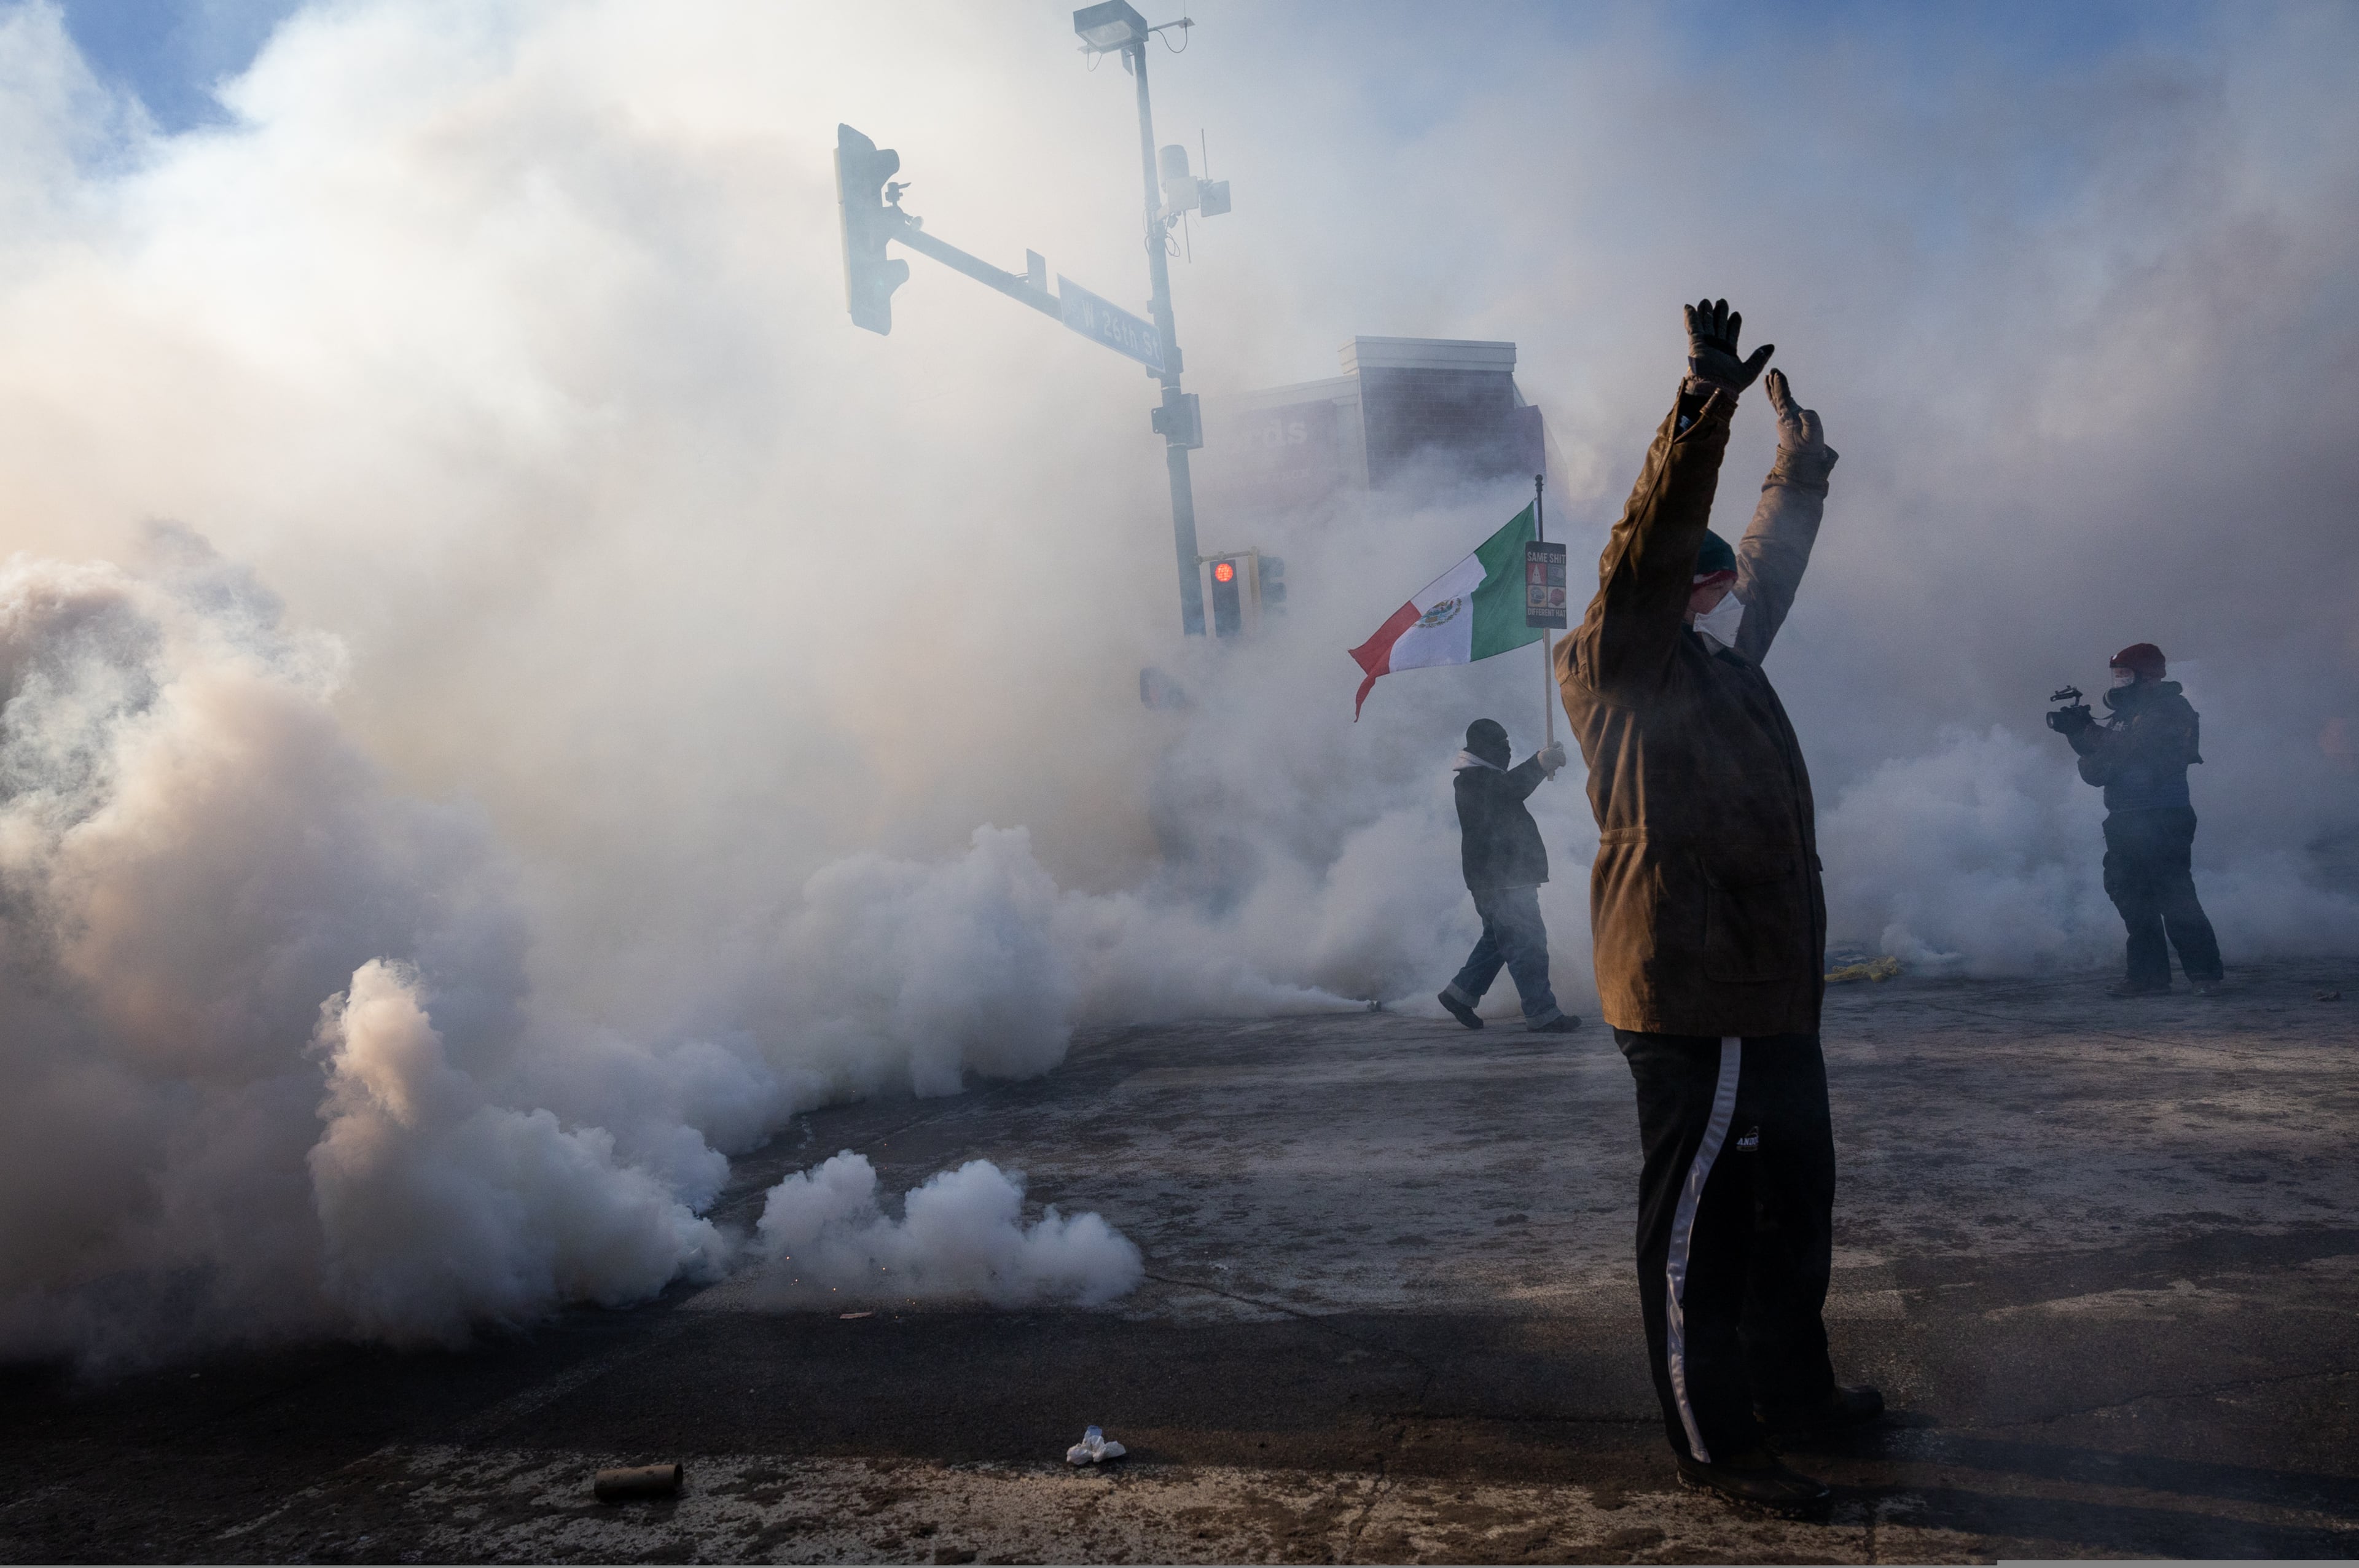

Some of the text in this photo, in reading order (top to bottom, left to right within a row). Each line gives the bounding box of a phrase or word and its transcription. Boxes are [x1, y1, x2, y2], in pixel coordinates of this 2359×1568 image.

[1082, 299, 1160, 361] W 26th St
[1527, 551, 1566, 564] SAME SHIT
[1528, 608, 1554, 617] DIFFERENT
